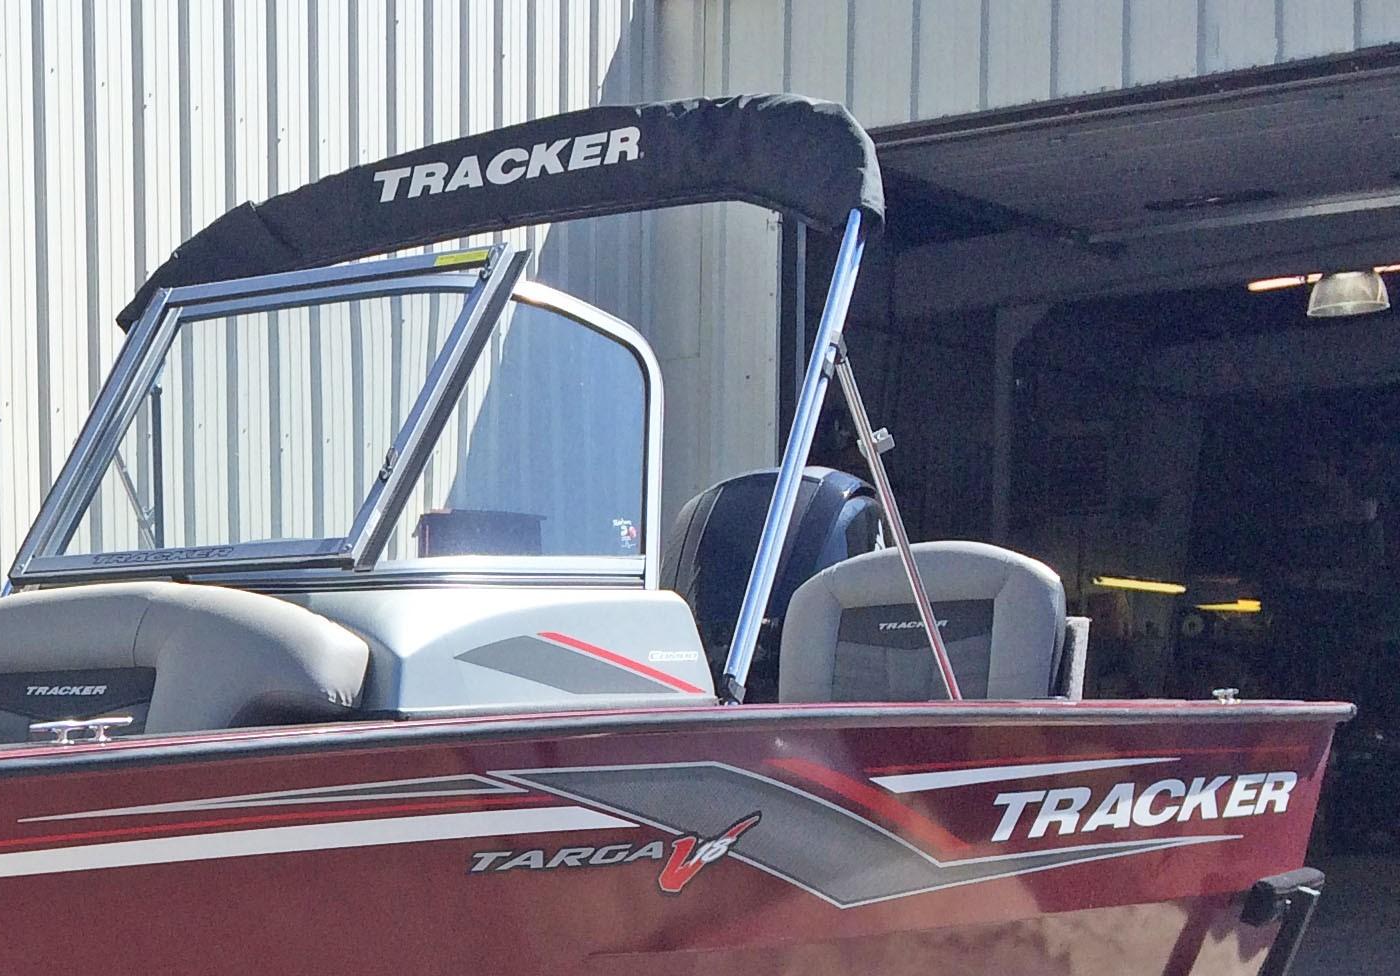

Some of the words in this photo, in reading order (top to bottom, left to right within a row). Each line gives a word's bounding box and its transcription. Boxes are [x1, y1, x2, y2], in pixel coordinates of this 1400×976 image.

[373, 126, 641, 203] TRACKER
[879, 619, 948, 630] TRACKR
[26, 685, 107, 696] TRACKER
[991, 771, 1298, 842] TRACKER
[470, 840, 664, 873] TARGA
